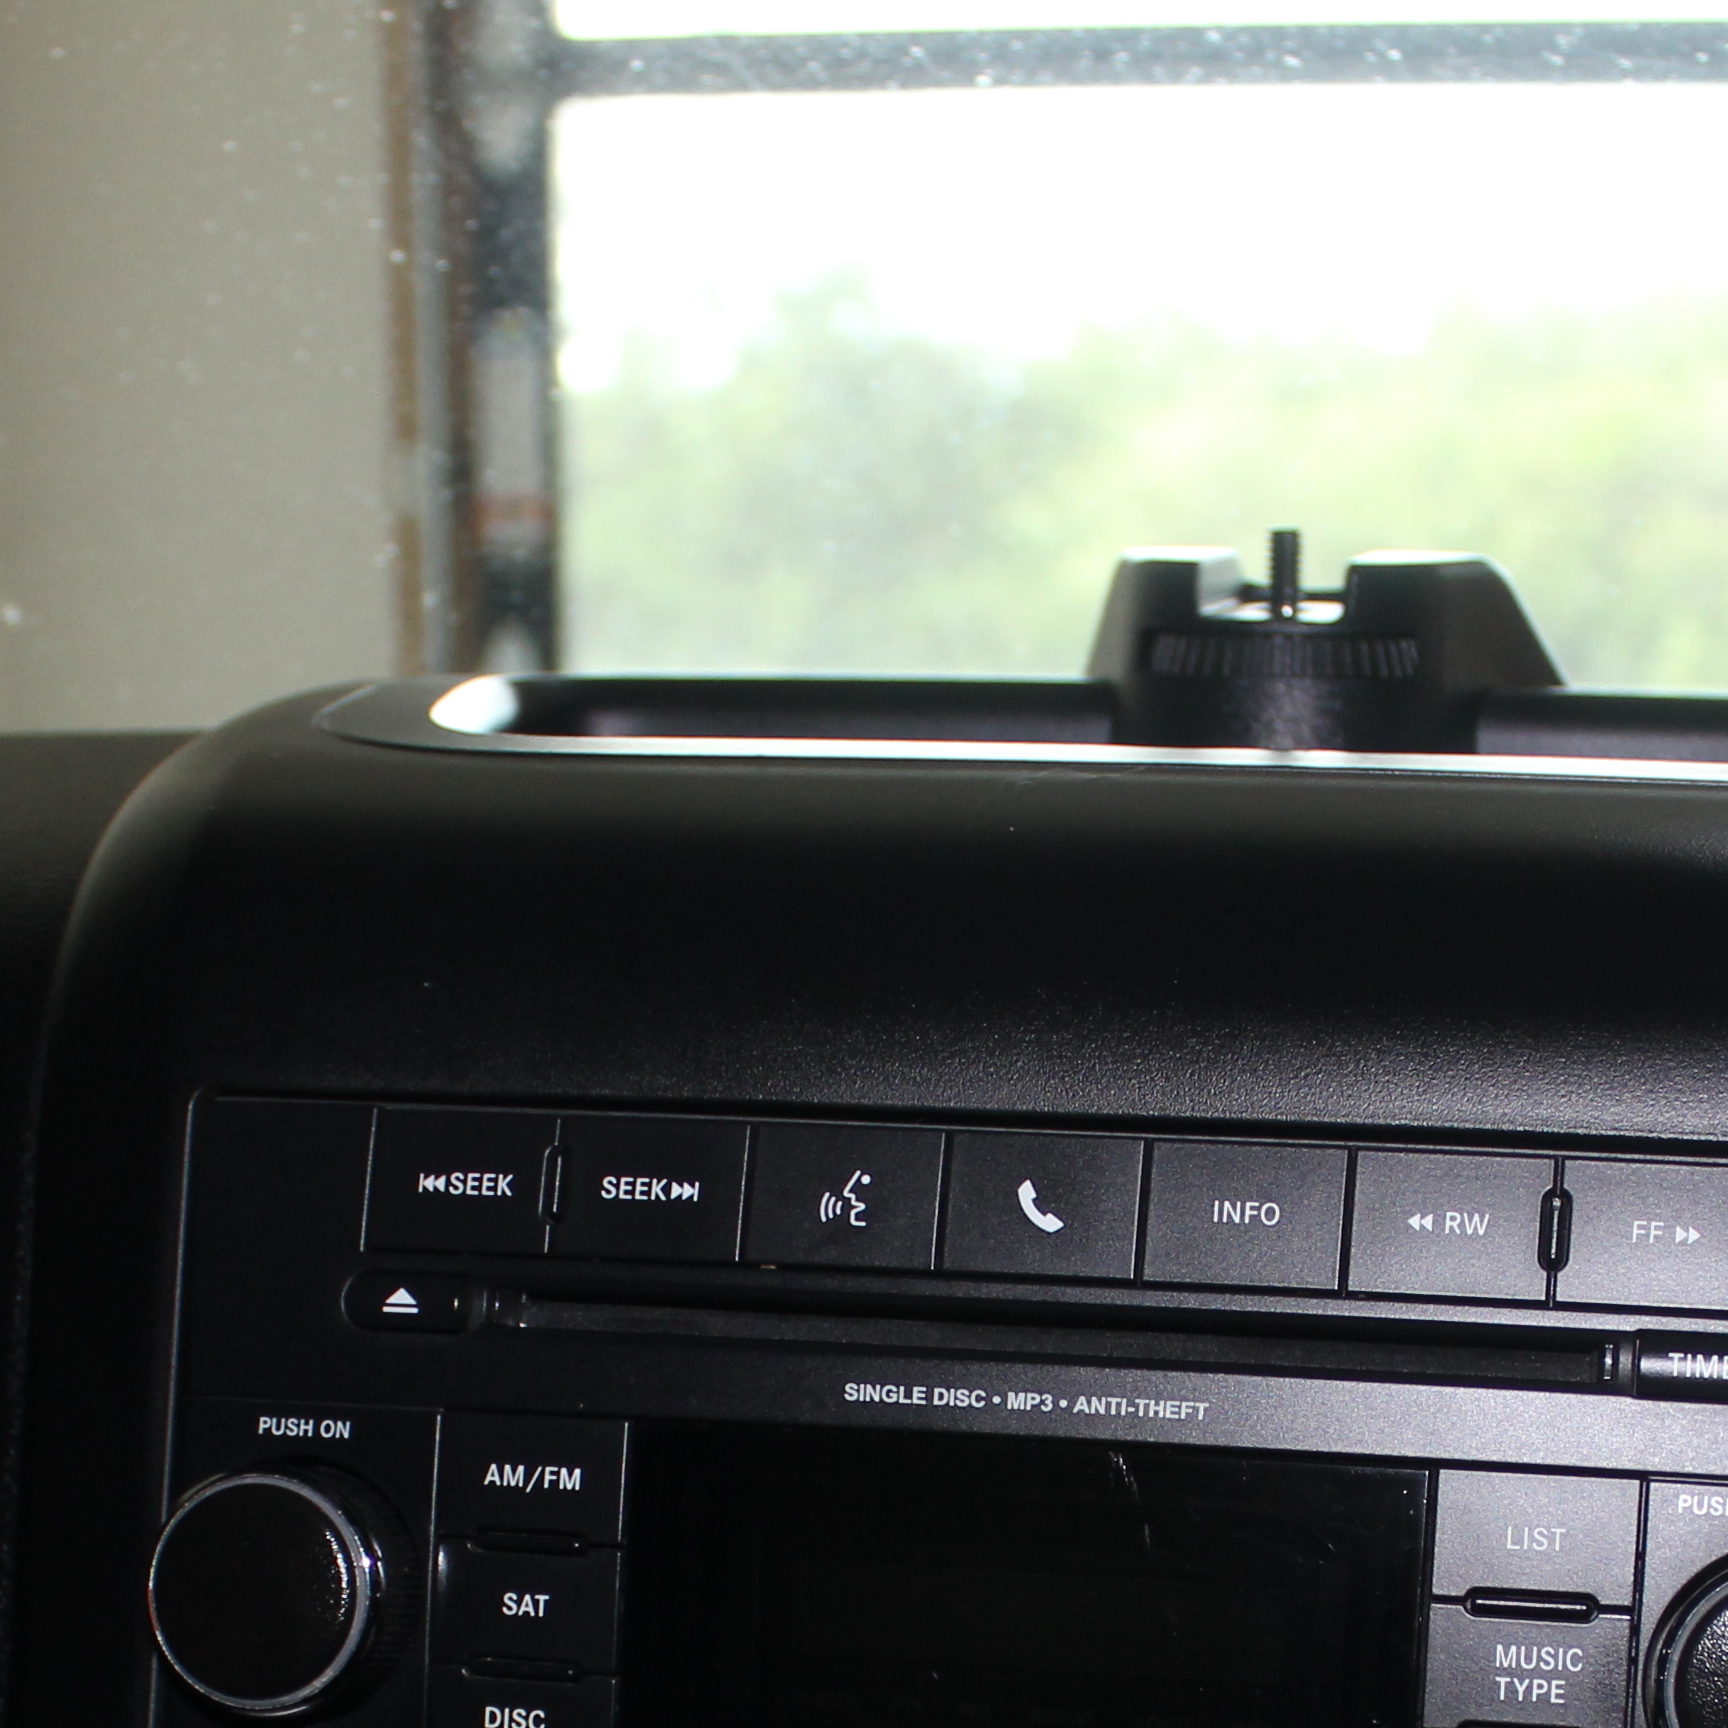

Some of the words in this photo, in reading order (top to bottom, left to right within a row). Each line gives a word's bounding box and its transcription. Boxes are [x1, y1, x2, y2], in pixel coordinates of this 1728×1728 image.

[448, 1171, 515, 1198] SEEK
[600, 1176, 668, 1202] SEEK
[1213, 1200, 1281, 1227] INFO
[1444, 1211, 1491, 1237] RW
[1631, 1220, 1666, 1245] FF
[844, 1382, 928, 1406] SINGLE
[933, 1387, 988, 1409] DISC
[1007, 1391, 1054, 1413] MP3
[1073, 1395, 1210, 1421] ANTI-THEFT
[257, 1416, 315, 1438] PUSH
[319, 1419, 352, 1440] ON
[483, 1463, 583, 1494] AM/FM
[1506, 1525, 1568, 1553] LIST
[502, 1592, 551, 1618] SAT
[1495, 1644, 1584, 1673] MUSIC
[1495, 1676, 1567, 1704] TYPE
